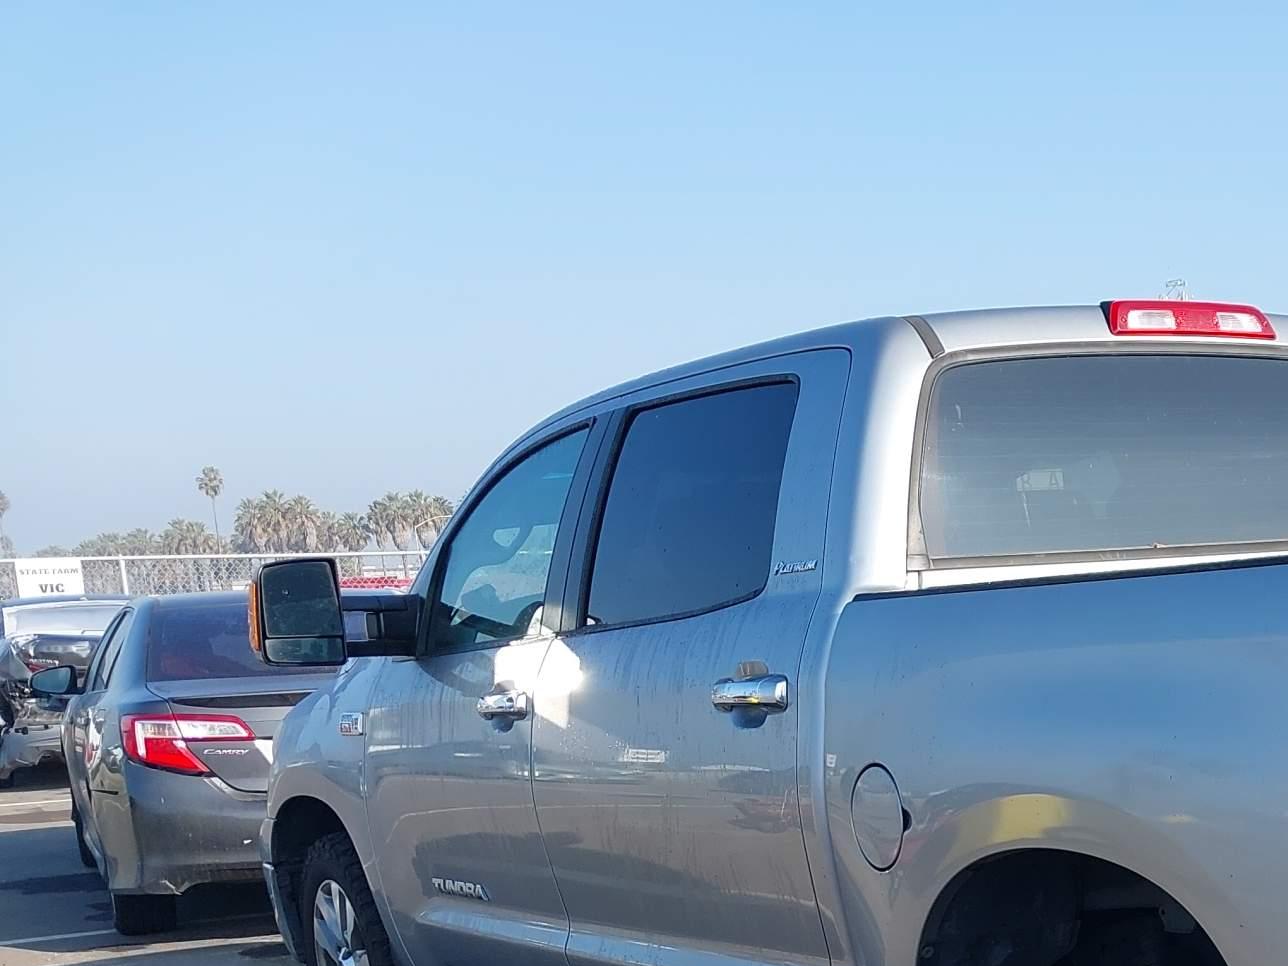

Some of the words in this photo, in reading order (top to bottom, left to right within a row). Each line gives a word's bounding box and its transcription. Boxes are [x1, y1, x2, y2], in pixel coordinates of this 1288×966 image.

[19, 567, 50, 576] STATE
[52, 567, 79, 575] FARM
[38, 583, 65, 593] VIC
[203, 748, 250, 756] CAMRY
[431, 877, 490, 901] TUNDRA
